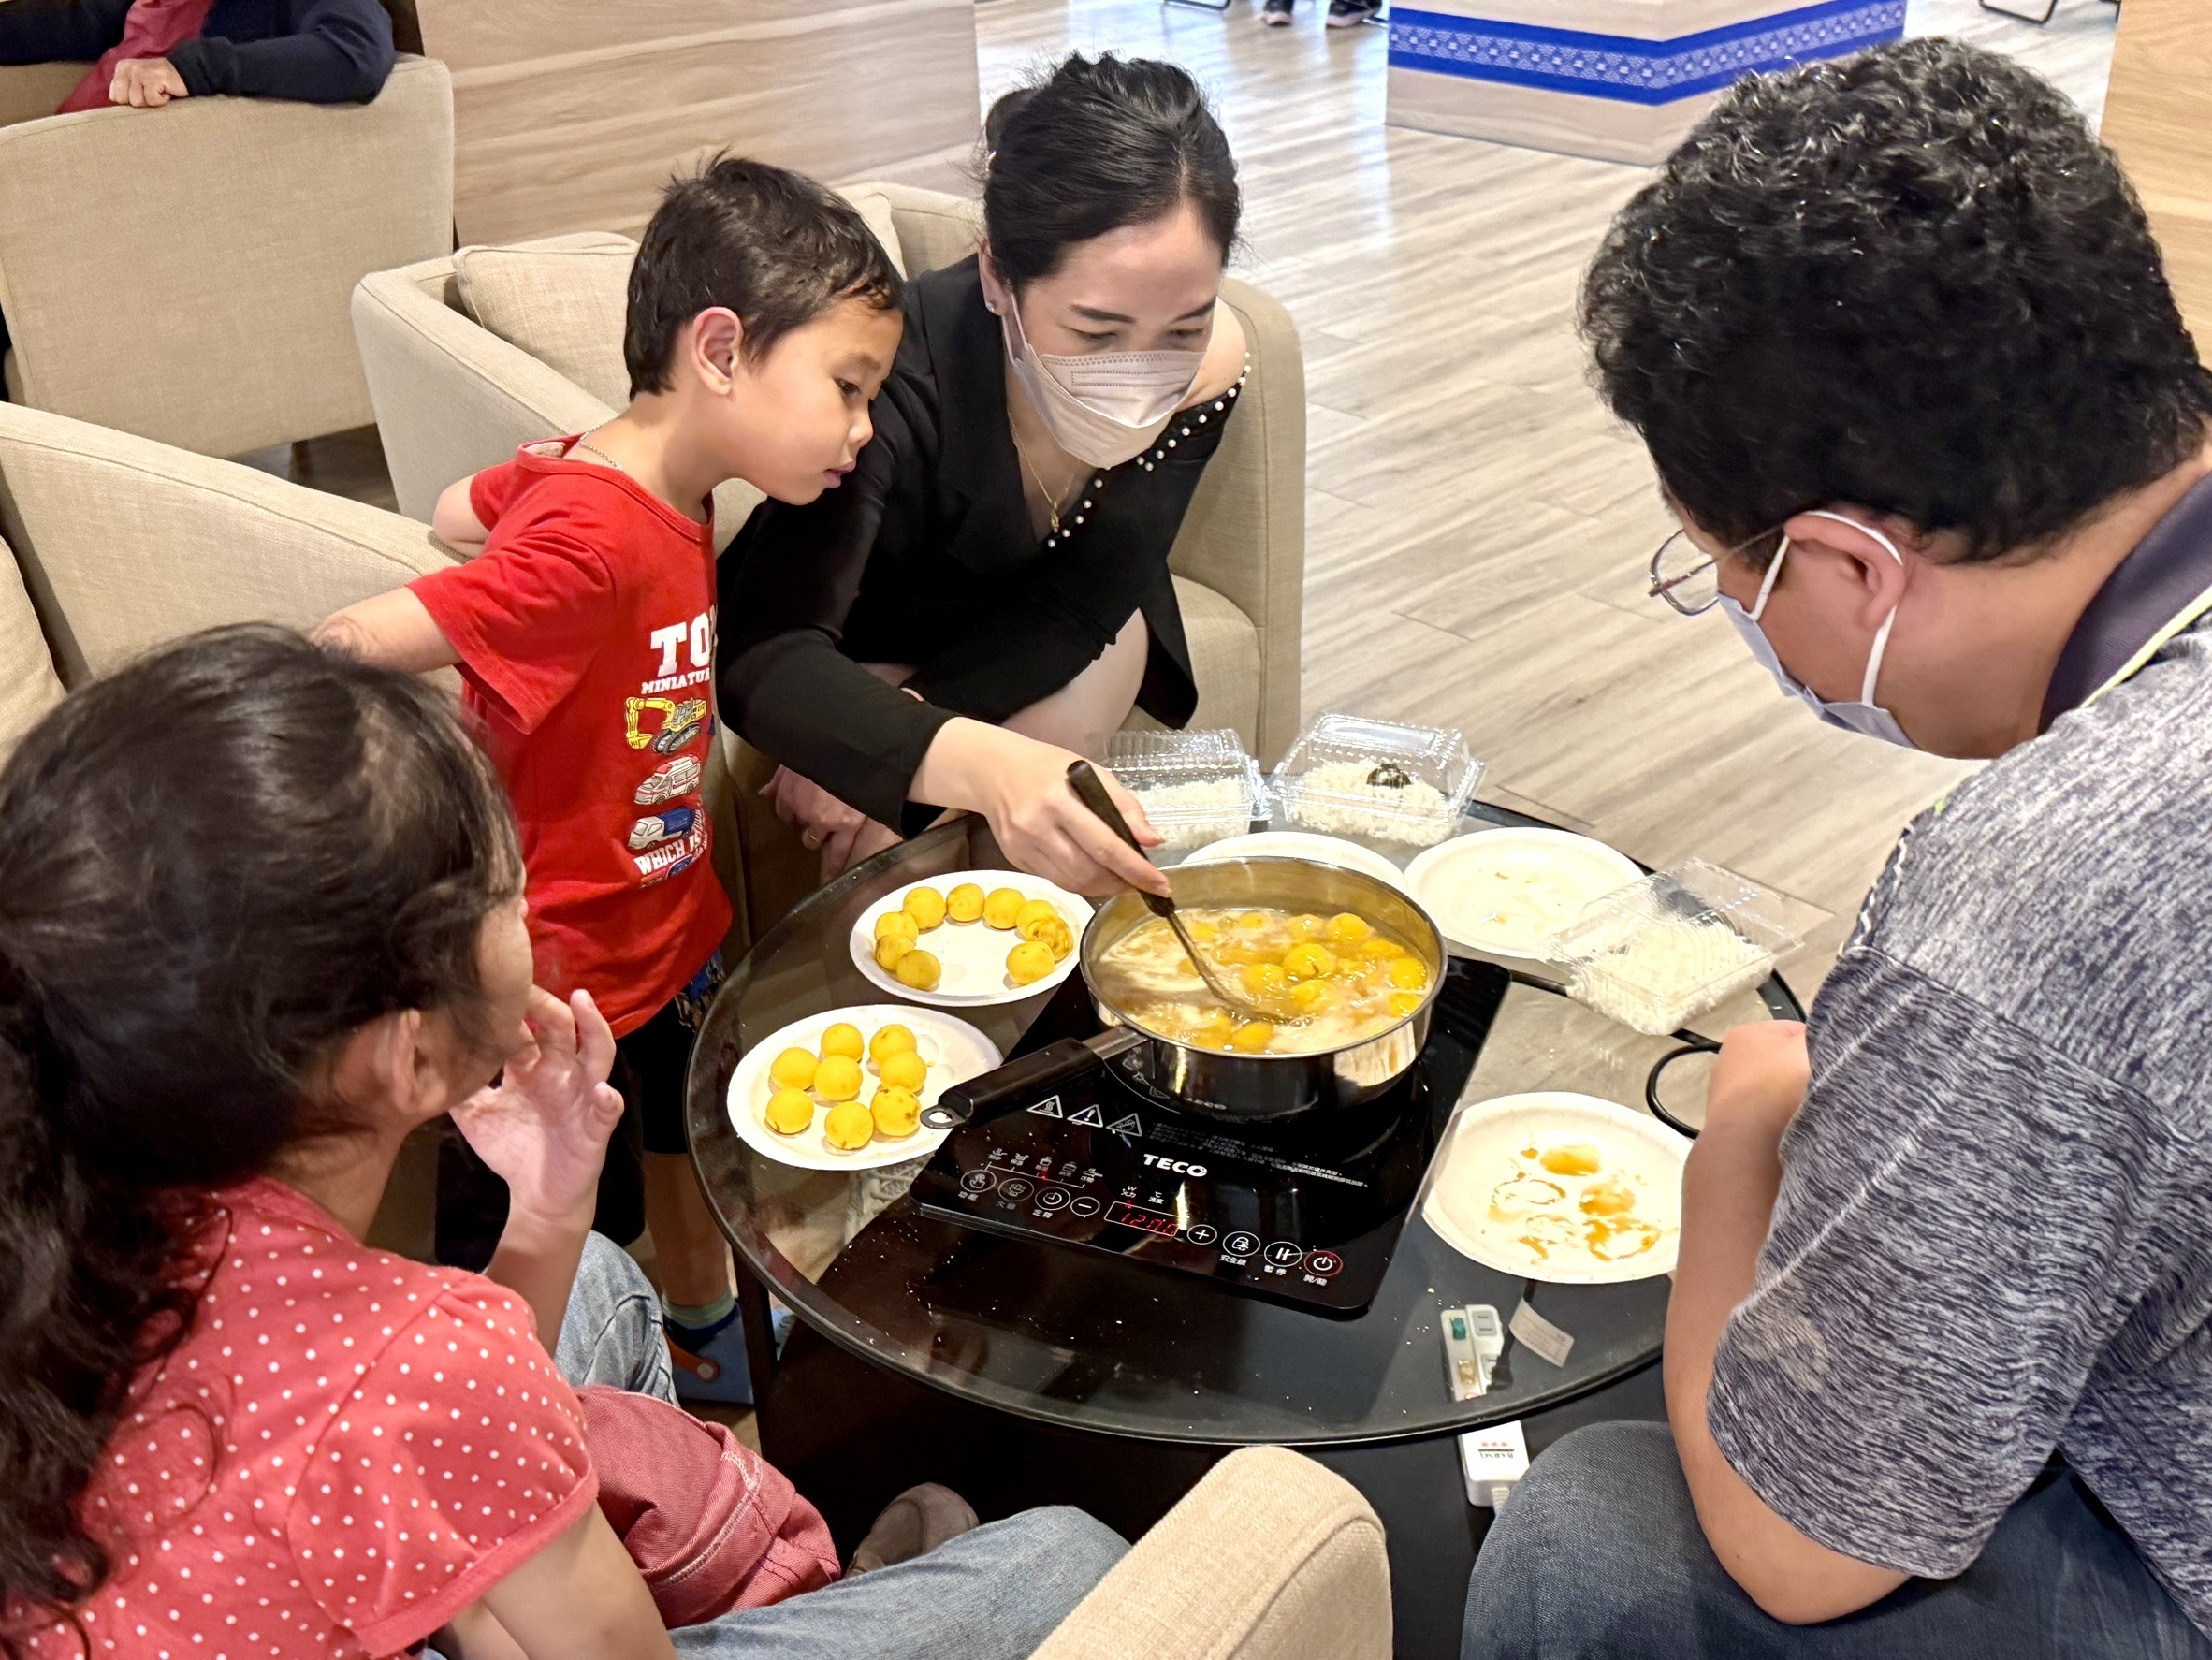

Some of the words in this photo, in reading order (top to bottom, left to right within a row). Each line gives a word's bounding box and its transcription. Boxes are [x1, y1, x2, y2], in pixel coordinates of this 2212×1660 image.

[650, 608, 716, 677] TO
[633, 839, 686, 875] WHICH
[1143, 1153, 1208, 1177] TECO
